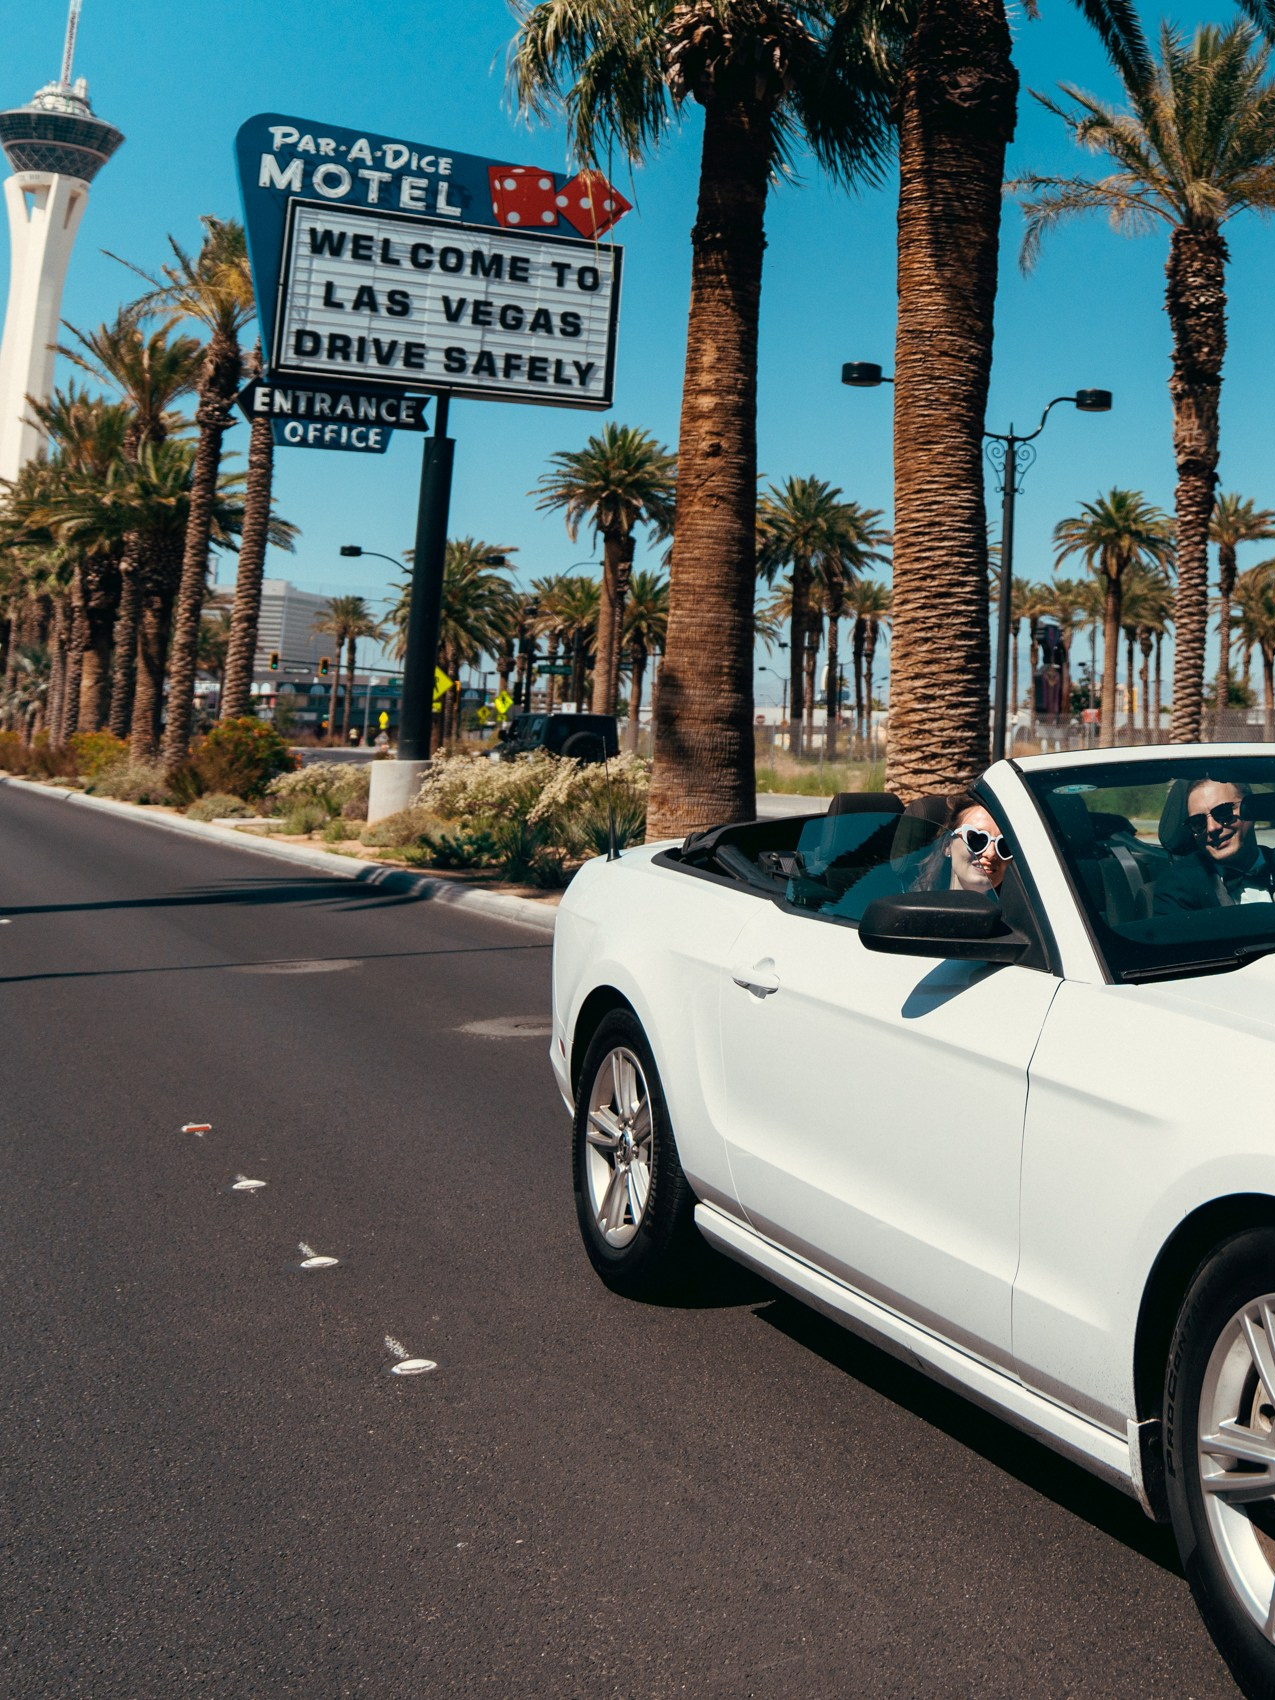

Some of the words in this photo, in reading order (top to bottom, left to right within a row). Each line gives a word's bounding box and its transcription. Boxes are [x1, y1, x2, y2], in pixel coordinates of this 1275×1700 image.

[258, 153, 462, 217] MOTEL
[309, 227, 531, 283] WELCOME
[551, 261, 600, 292] TO
[322, 280, 410, 317] LAS
[442, 295, 582, 338] VEGAS
[293, 329, 426, 369] DRIVE
[443, 346, 595, 387] SAFELY
[252, 386, 417, 424] ENTRANCE
[283, 420, 383, 450] OFFICE
